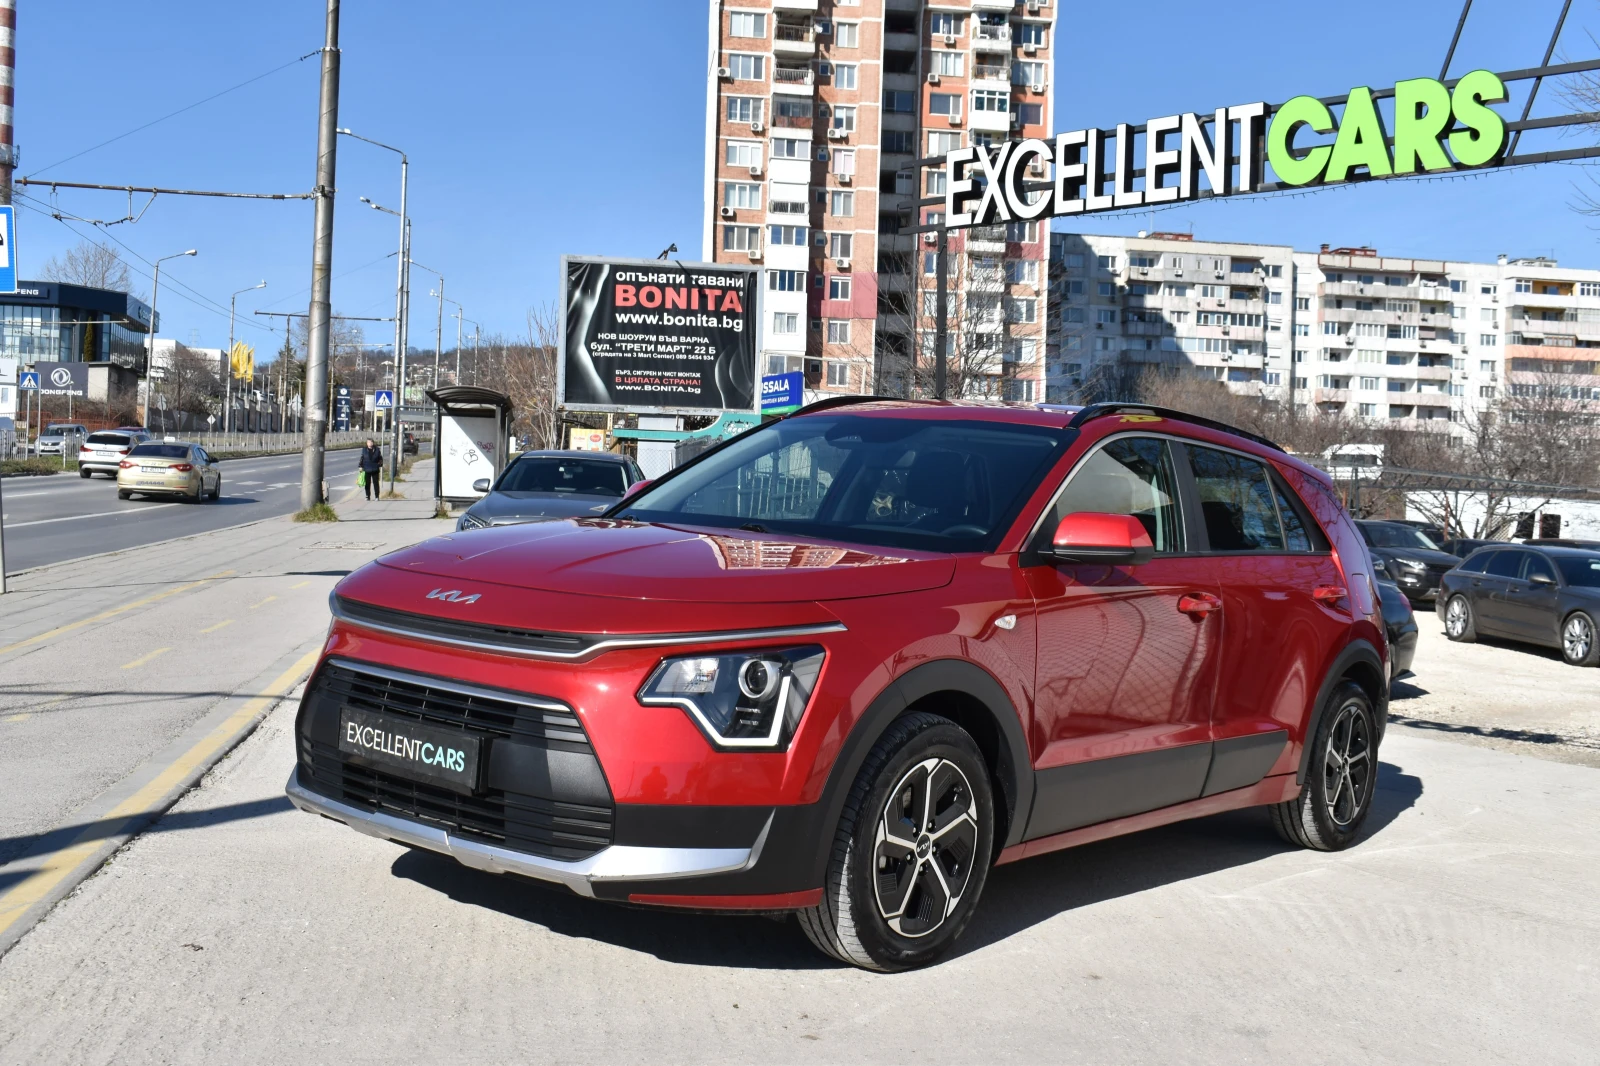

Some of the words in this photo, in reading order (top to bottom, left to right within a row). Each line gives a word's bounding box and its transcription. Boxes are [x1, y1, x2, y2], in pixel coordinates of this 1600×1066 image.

[615, 271, 685, 285] опънати
[690, 274, 744, 288] тавани
[15, 288, 39, 296] FENG
[615, 284, 743, 313] BONITA
[615, 312, 744, 333] www.bonita.bg
[597, 332, 617, 340] НОВ
[618, 333, 656, 342] ШОУРУМ
[658, 335, 678, 343] ВЪВ
[679, 336, 709, 344] ВАРНА
[590, 342, 613, 351] бул.
[694, 346, 706, 354] 22
[708, 346, 716, 354] Б
[662, 378, 701, 386] СТРАНА!
[40, 388, 83, 396] DONGFENG
[615, 384, 701, 394] www.BONITA.bg
[425, 587, 482, 606] KIA
